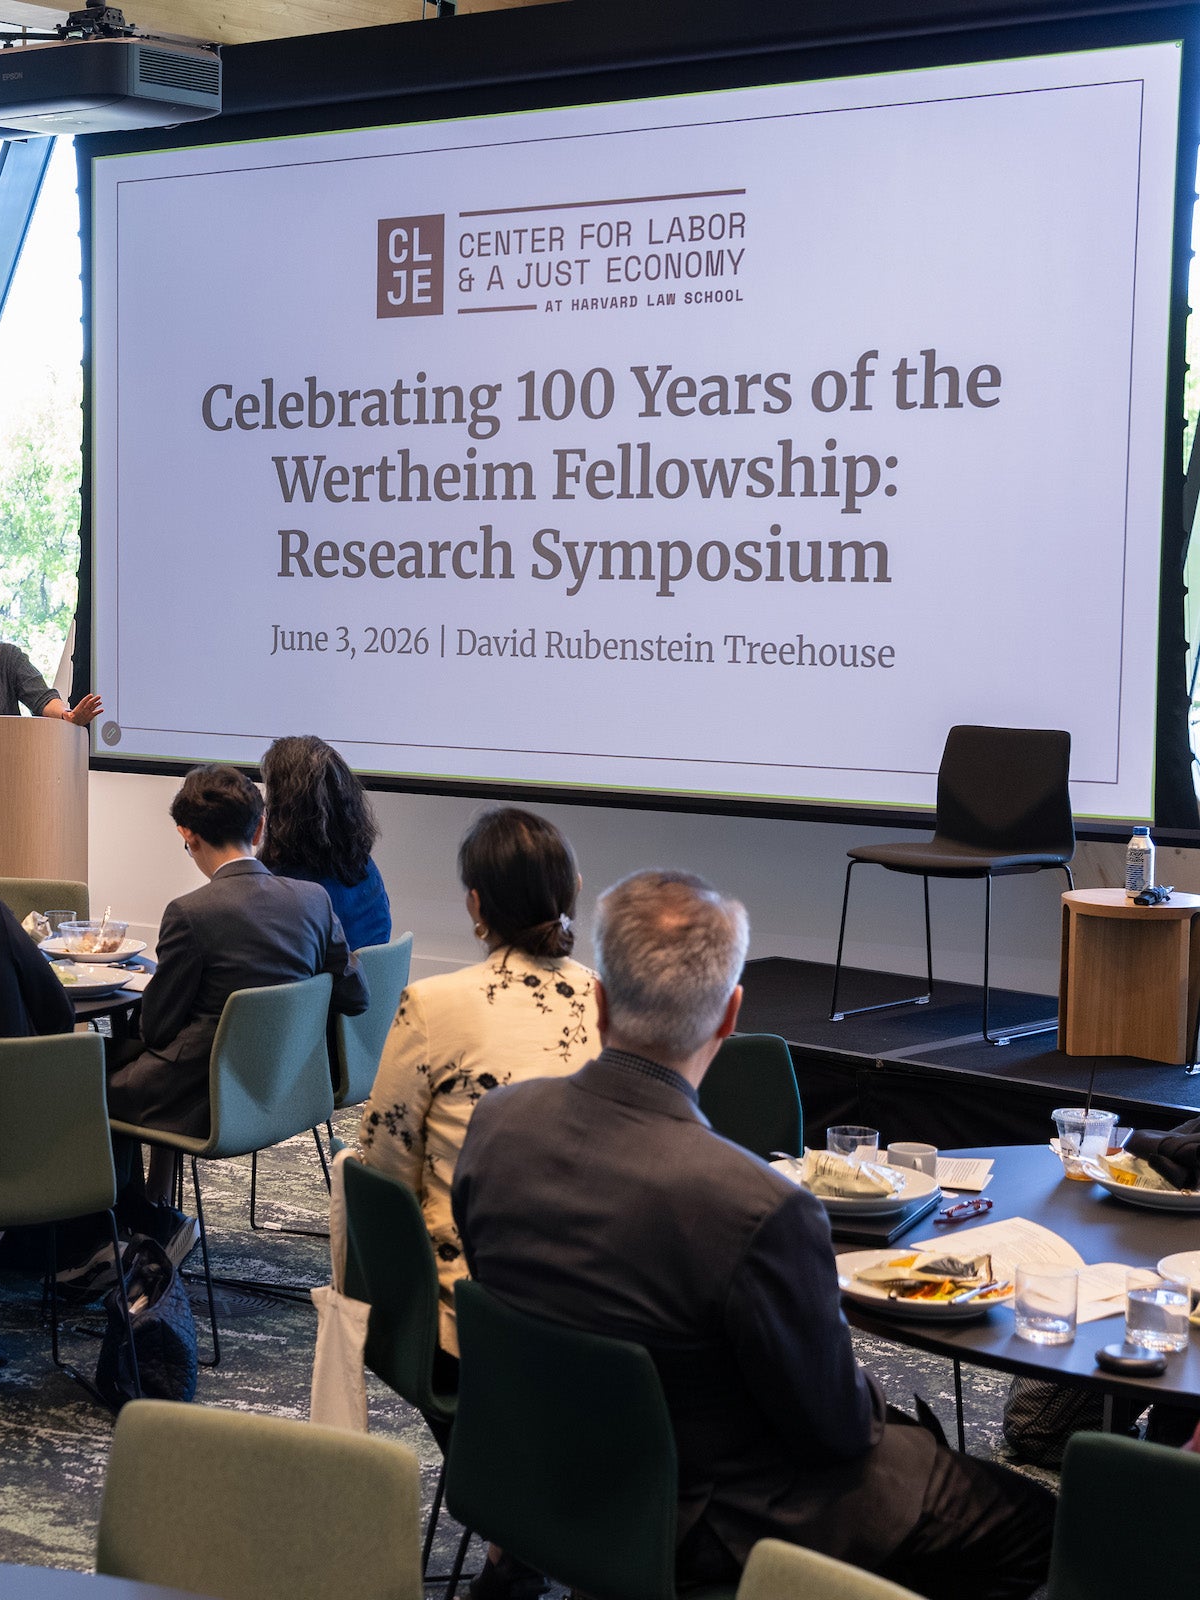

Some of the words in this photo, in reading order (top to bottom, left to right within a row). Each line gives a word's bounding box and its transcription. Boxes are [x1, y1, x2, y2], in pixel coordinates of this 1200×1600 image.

[1, 71, 23, 81] EPSON
[387, 227, 433, 264] CL
[459, 226, 565, 259] CENTER
[580, 220, 632, 250] FOR
[648, 211, 746, 245] LABOR
[387, 268, 432, 306] JE
[458, 266, 476, 293] &
[486, 264, 505, 292] A
[516, 258, 591, 290] JUST
[606, 247, 746, 284] ECONOMY
[544, 299, 563, 313] AT
[571, 295, 638, 312] HARVARD
[646, 292, 676, 307] LAW
[683, 288, 744, 305] SCHOOL
[201, 371, 503, 441] Celebrating
[517, 367, 615, 422] 100
[629, 364, 793, 418] Years
[810, 349, 880, 414] of
[891, 347, 1002, 411] the
[271, 446, 537, 504] Wertheim
[551, 437, 899, 515] Fellowship:
[277, 524, 516, 580] Research
[531, 523, 893, 598] Symposium
[269, 624, 329, 656] June
[335, 626, 356, 661] 3,
[363, 626, 430, 655] 2026
[455, 628, 537, 658] David
[544, 628, 715, 664] Rubenstein
[723, 633, 896, 669] Treehouse
